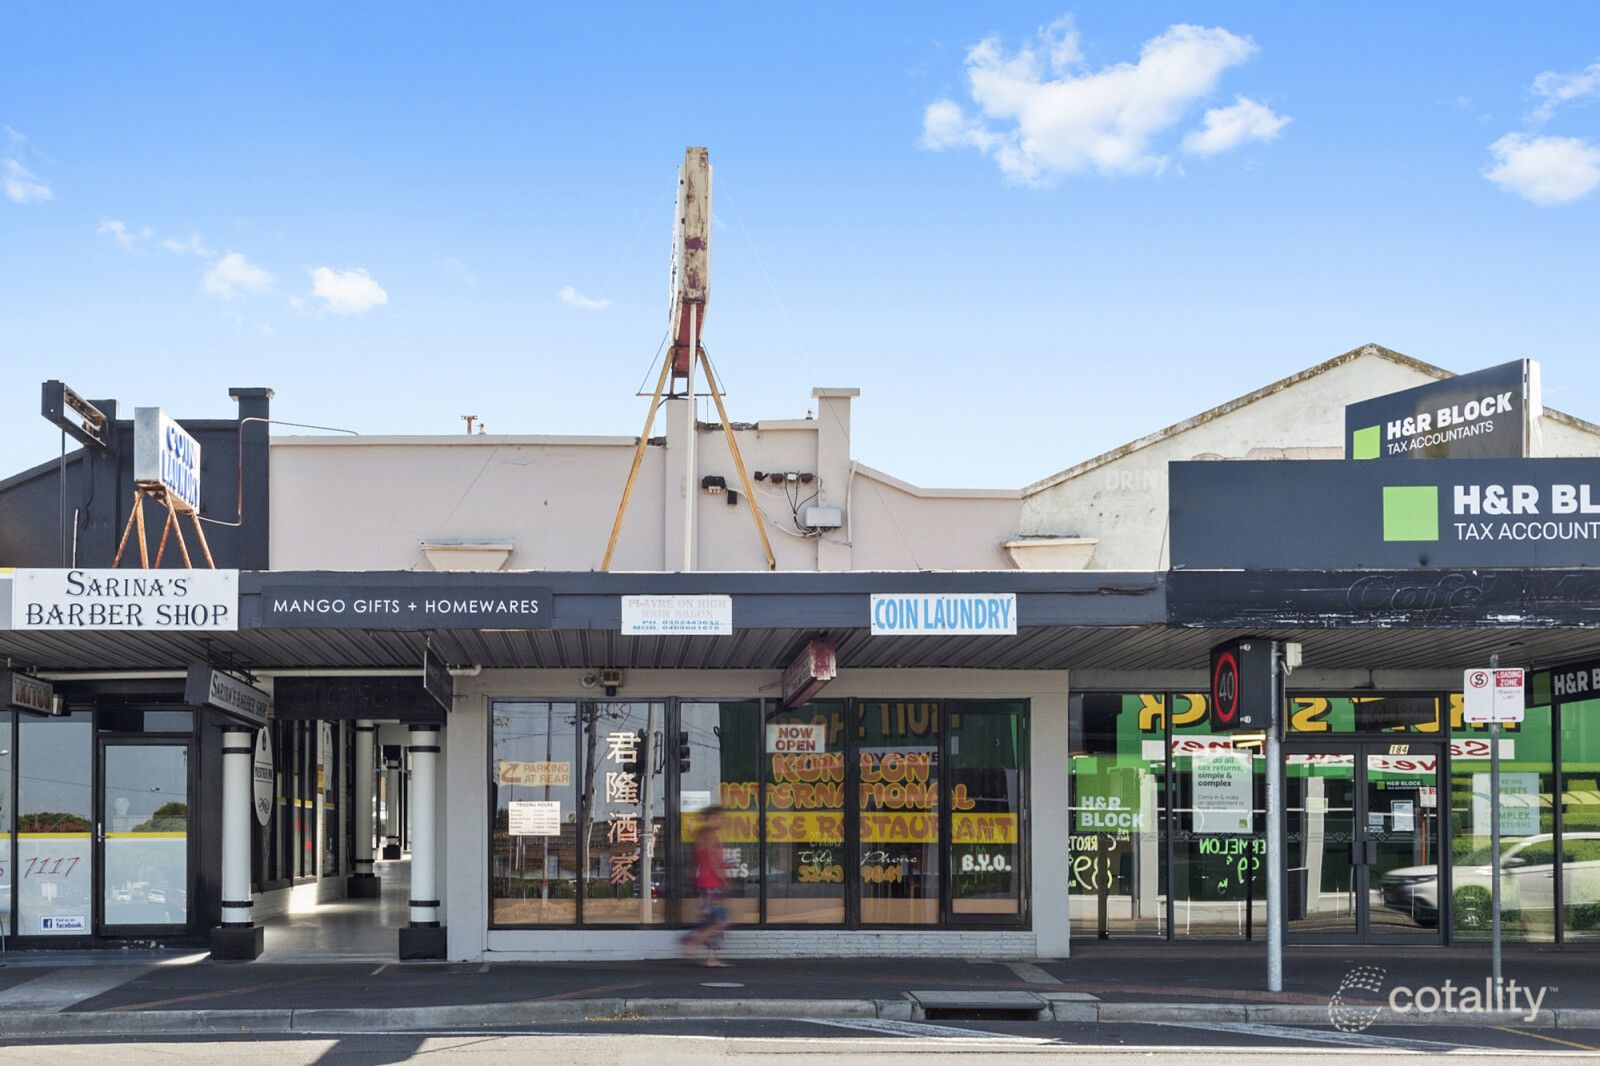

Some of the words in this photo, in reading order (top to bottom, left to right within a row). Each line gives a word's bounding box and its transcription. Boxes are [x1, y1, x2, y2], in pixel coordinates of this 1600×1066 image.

[1387, 413, 1432, 440] H&R
[1436, 392, 1513, 428] BLOCK
[1387, 441, 1408, 455] TAX
[1409, 420, 1494, 450] ACCOUNTANTS
[1454, 484, 1540, 515] H&R
[1454, 522, 1494, 541] TAX
[66, 570, 188, 598] SARINA'S
[26, 602, 143, 627] BARBER
[156, 604, 228, 626] SHOP
[273, 599, 345, 613] MANGO
[353, 599, 400, 614] GIFTS
[425, 599, 539, 614] HOMEWARES
[875, 598, 919, 629] COIN
[923, 598, 1011, 629] LAUNDRY
[1496, 671, 1522, 679] LOADING
[1553, 671, 1589, 696] H&R
[1219, 671, 1235, 699] 40
[778, 727, 813, 739] NOW
[775, 740, 816, 752] OPEN
[1391, 746, 1408, 755] 184
[523, 764, 569, 773] PARKING
[1198, 772, 1225, 780] simple
[524, 775, 537, 784] AT
[540, 775, 569, 784] REAR
[1197, 780, 1232, 788] complex
[720, 781, 976, 811] INTERNTIONAL
[1081, 797, 1121, 810] H&R
[1081, 813, 1144, 827] BLOCK
[24, 856, 80, 879] 7117
[961, 853, 1012, 872] B.Y.O.
